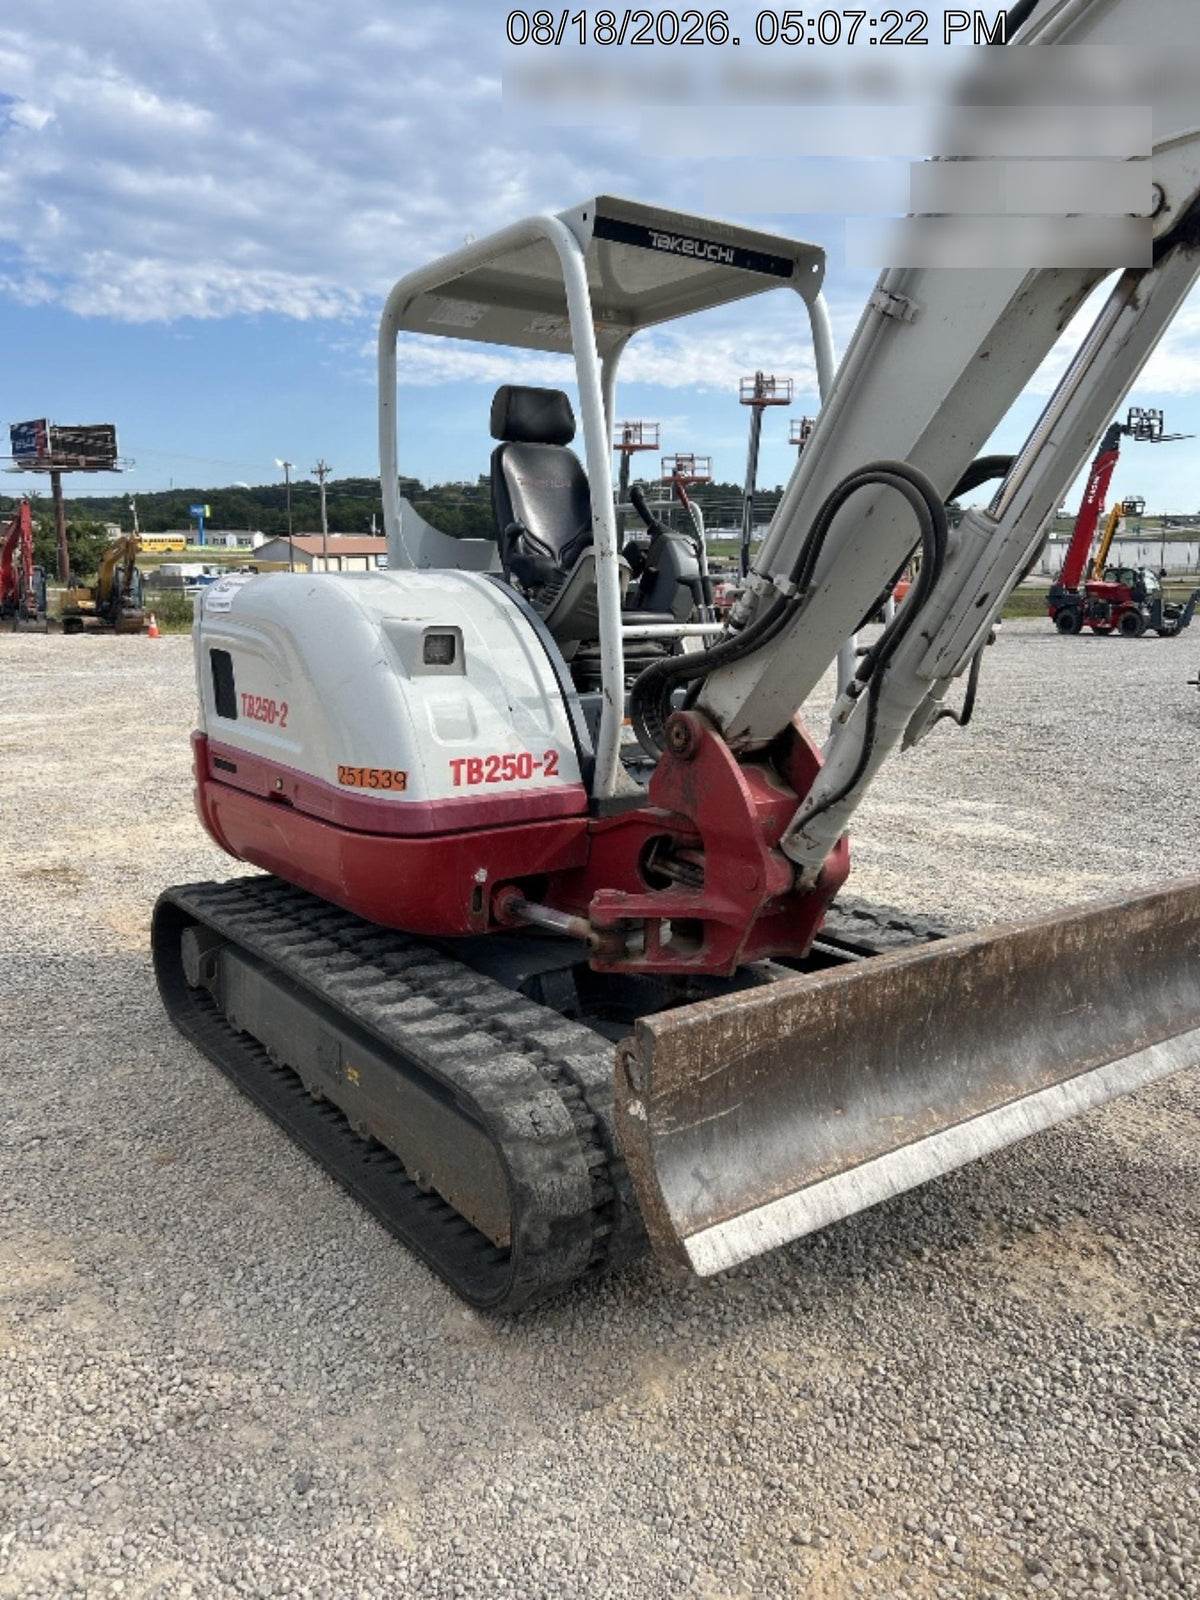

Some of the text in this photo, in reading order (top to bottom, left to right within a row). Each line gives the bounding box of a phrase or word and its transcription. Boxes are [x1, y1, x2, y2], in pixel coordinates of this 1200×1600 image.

[648, 230, 735, 263] TAKEUCHI
[241, 692, 288, 728] TB250-2
[337, 765, 407, 791] 251539
[449, 749, 559, 787] TB250-2
